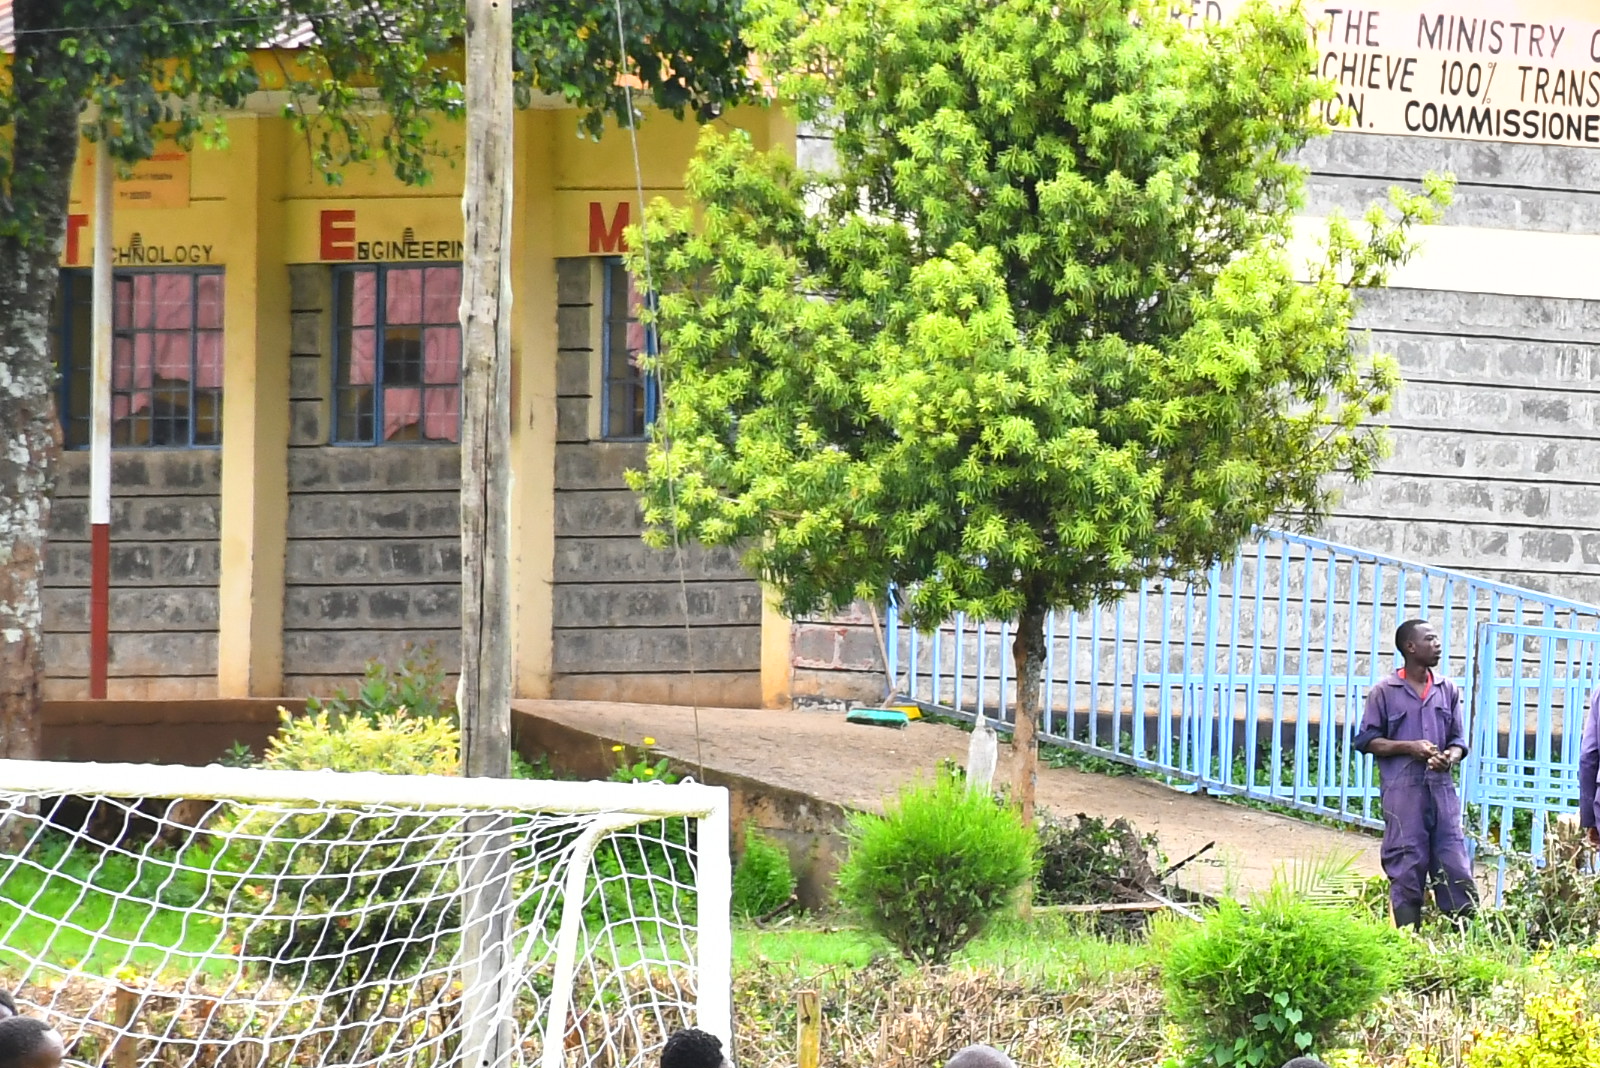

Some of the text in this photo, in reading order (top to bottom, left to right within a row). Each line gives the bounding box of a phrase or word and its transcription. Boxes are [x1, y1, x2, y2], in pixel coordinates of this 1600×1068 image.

[1324, 8, 1380, 47] THE
[1417, 13, 1565, 59] MINISTRY
[1440, 59, 1498, 106] 100%
[589, 202, 630, 253] M
